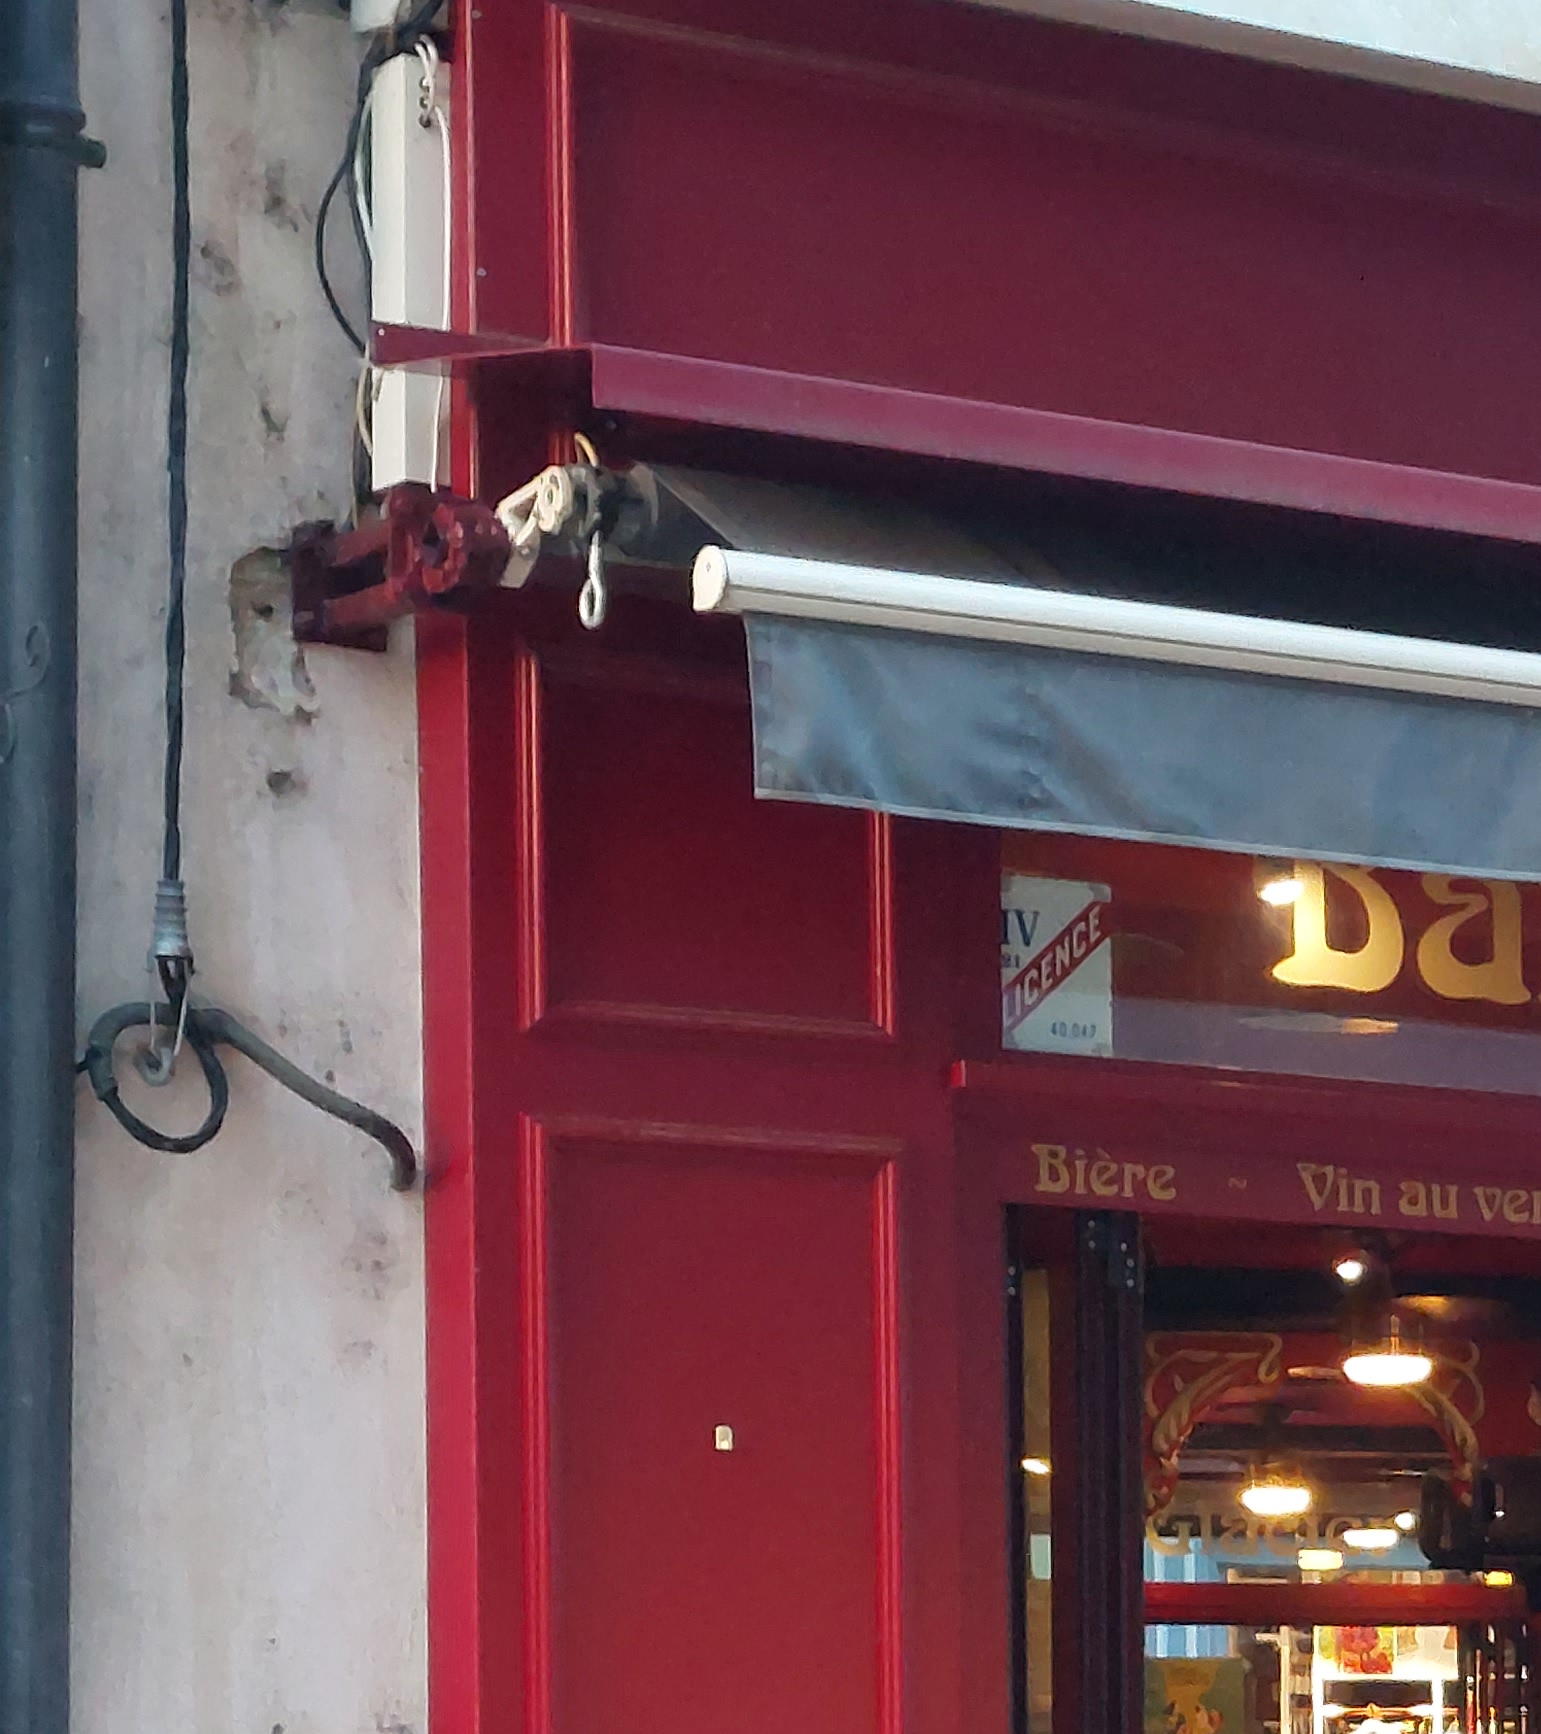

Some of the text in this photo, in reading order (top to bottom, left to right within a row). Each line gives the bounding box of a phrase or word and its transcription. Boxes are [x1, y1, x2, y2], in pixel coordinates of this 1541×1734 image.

[1002, 903, 1103, 1025] LICENCE
[1031, 1144, 1177, 1200] Bière
[1298, 1163, 1381, 1216] Vin
[1399, 1183, 1457, 1219] au
